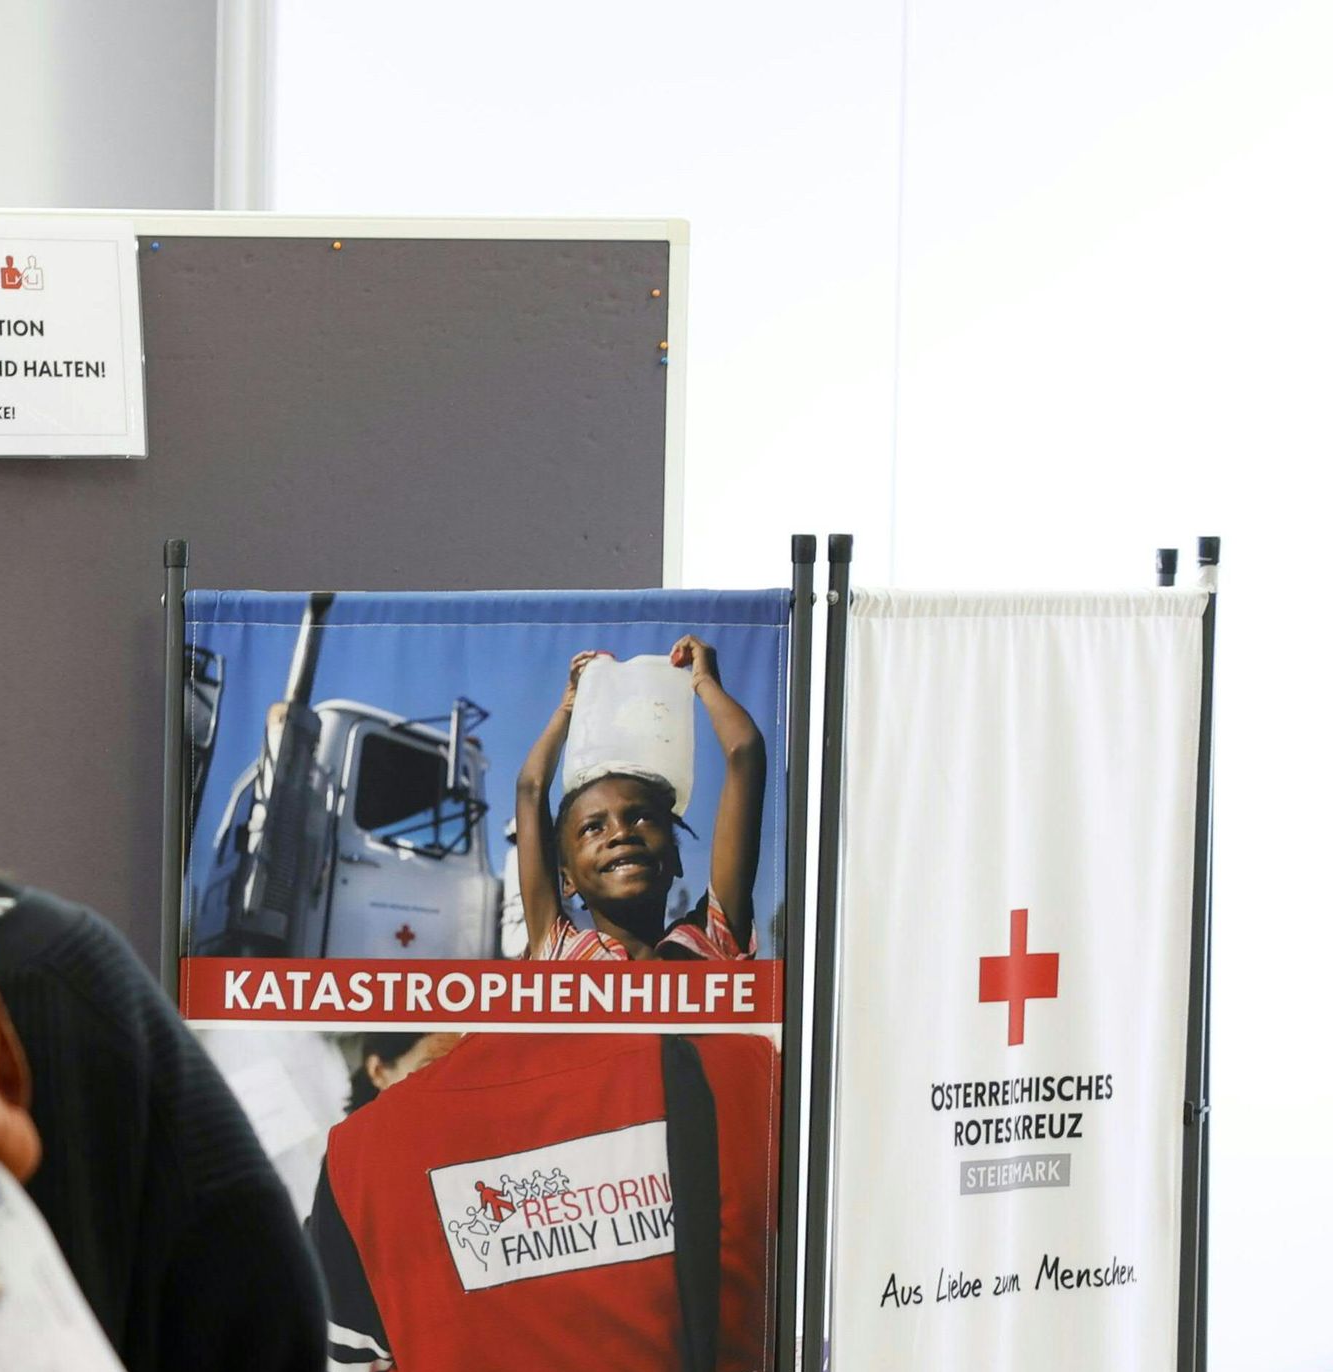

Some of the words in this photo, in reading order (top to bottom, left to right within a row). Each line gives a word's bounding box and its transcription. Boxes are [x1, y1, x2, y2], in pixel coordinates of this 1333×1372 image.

[22, 360, 106, 379] HALTEN!
[224, 970, 756, 1013] KATASTROPHENHILFE
[930, 1073, 1114, 1112] ÖSTERREICHISCHES
[953, 1116, 1012, 1147] ROTES
[1013, 1112, 1084, 1142] KREUZ
[965, 1159, 1062, 1189] STEIERMARK
[522, 1172, 673, 1230] RESTORIN
[500, 1220, 599, 1267] FAMILY
[880, 1272, 924, 1308] Aus
[935, 1267, 983, 1304] Liebe
[992, 1272, 1021, 1297] zum
